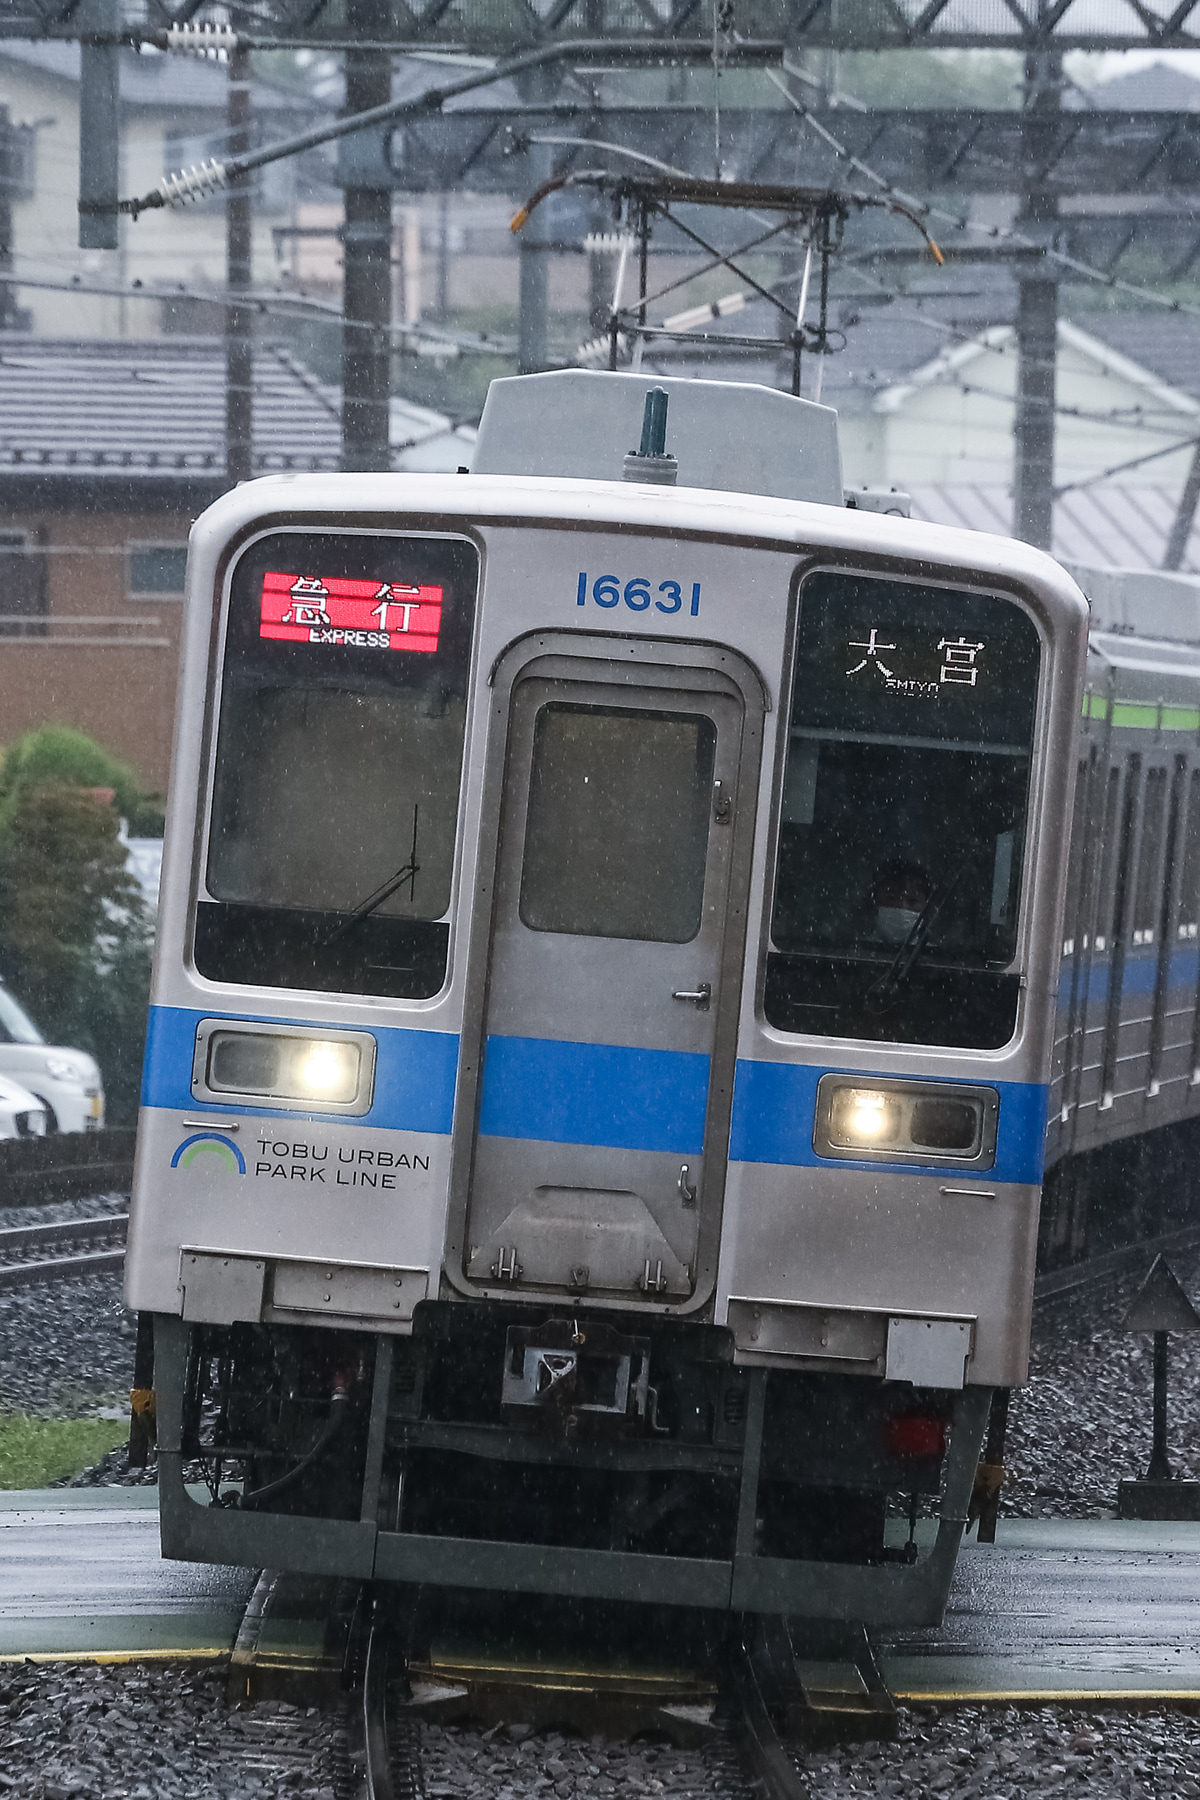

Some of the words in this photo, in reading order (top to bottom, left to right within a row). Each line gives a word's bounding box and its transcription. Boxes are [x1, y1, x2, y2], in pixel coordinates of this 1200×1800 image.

[282, 575, 420, 632] 急行
[576, 572, 701, 616] 16631
[309, 628, 390, 648] EXPRESS
[845, 628, 985, 686] 大宮
[256, 1139, 329, 1161] TOBU
[337, 1147, 430, 1171] URBAN
[255, 1162, 326, 1183] PARK
[336, 1169, 397, 1190] LINE
